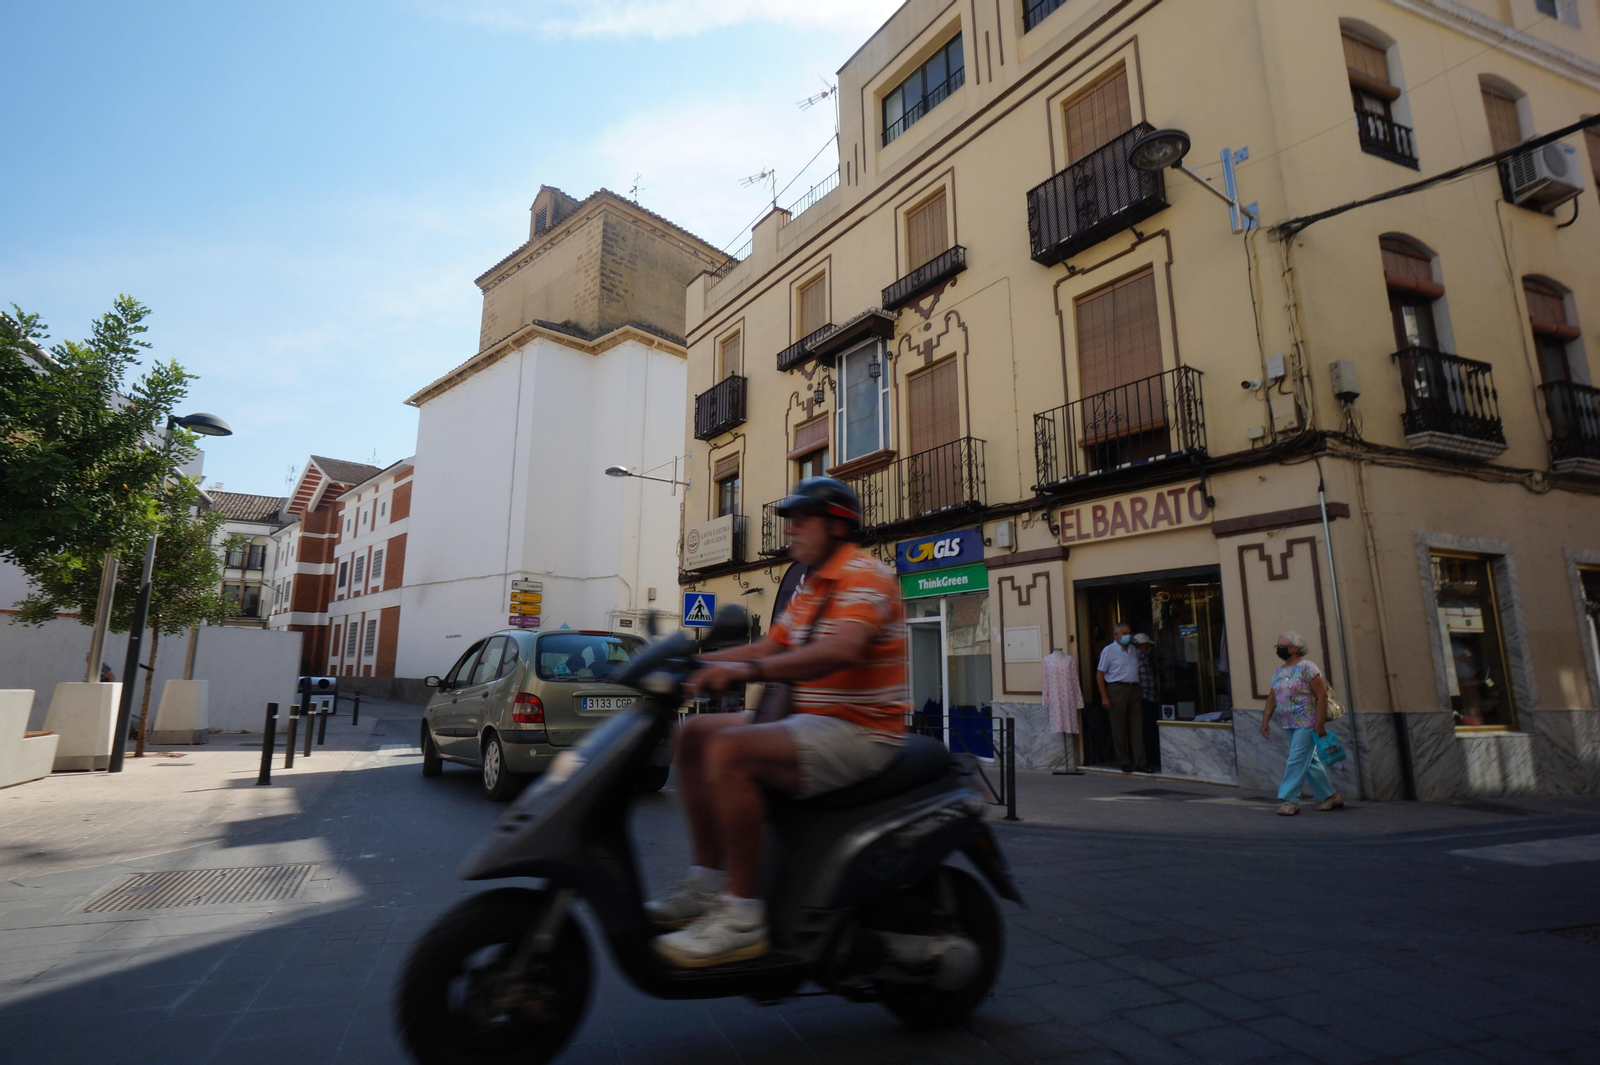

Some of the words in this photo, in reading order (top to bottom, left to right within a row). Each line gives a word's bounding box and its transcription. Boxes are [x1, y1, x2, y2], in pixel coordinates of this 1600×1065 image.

[713, 525, 731, 536] CASTRO
[704, 534, 727, 546] ABOGADOS
[933, 537, 961, 559] GLS
[918, 575, 968, 590] ThinkGreen
[588, 698, 612, 709] 3133
[615, 698, 632, 709] CGP
